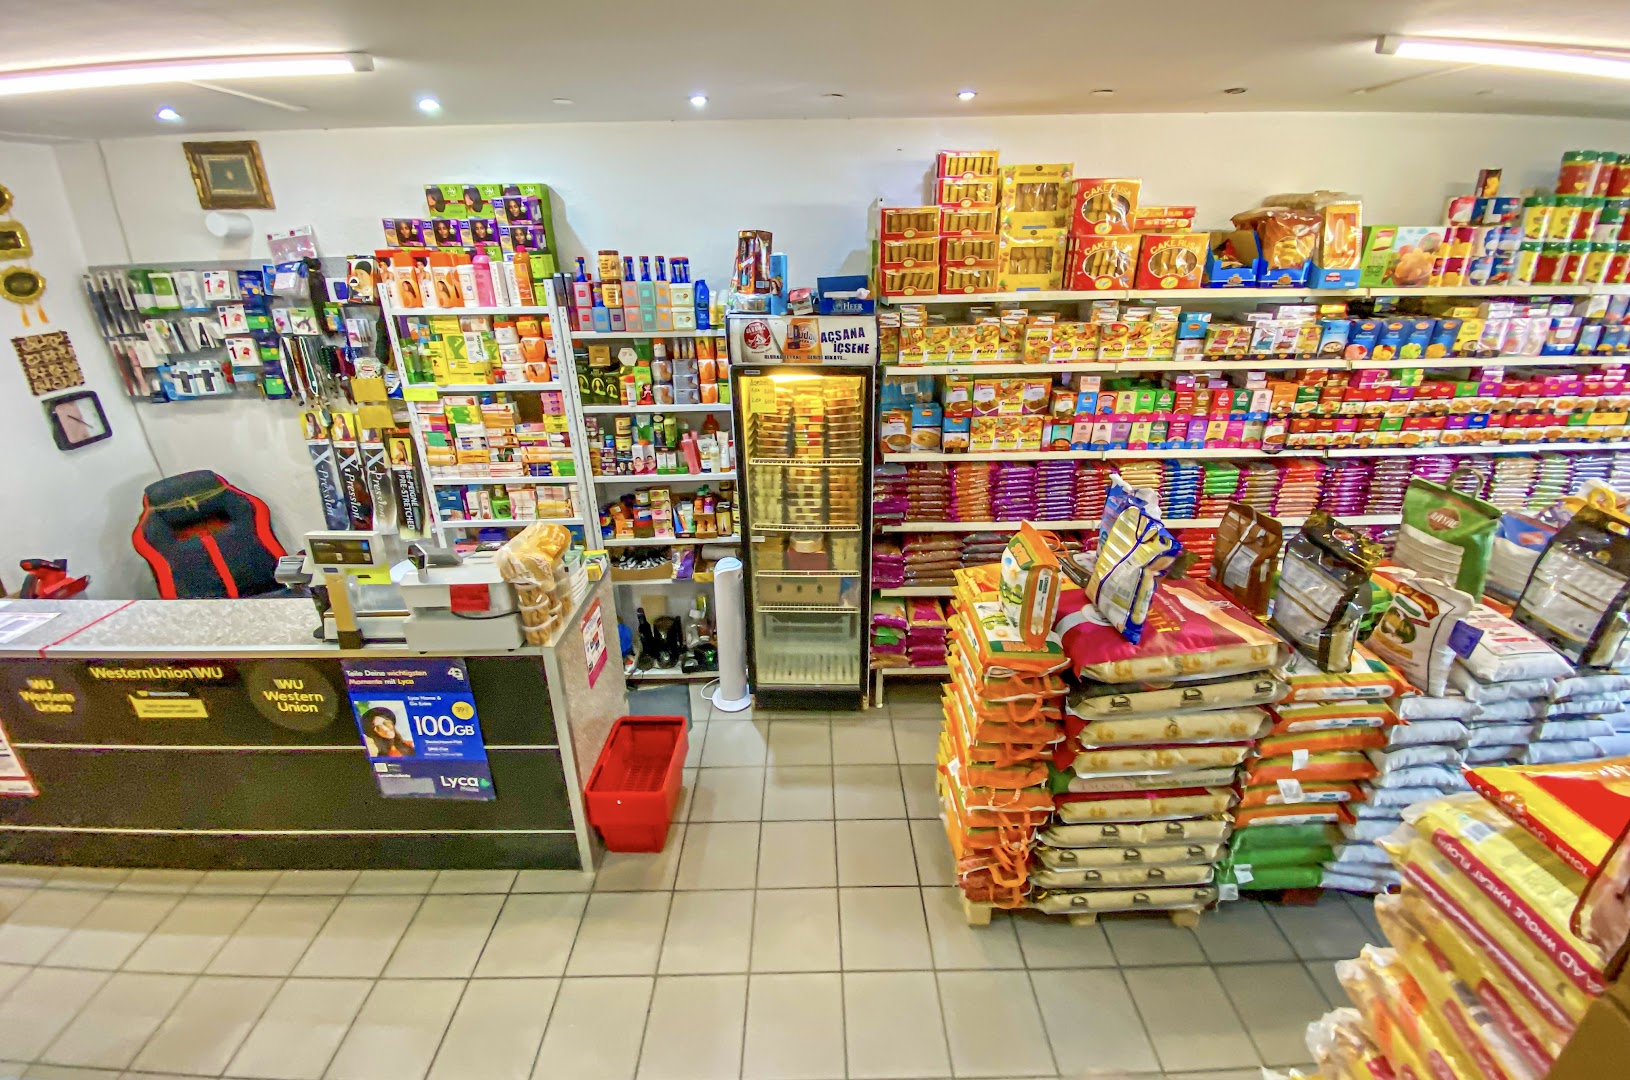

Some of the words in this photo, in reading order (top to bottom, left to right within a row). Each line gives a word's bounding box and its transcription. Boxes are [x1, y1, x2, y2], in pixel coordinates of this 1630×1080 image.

[1083, 184, 1109, 199] CAKE
[1084, 241, 1109, 256] CAKE
[1150, 240, 1176, 254] CAKE
[843, 302, 863, 310] HEER
[820, 327, 866, 344] AÇSANA
[398, 474, 415, 530] PRE-STRETCHED
[276, 680, 304, 690] WU
[263, 690, 324, 702] Western
[278, 702, 318, 712] Union
[440, 776, 480, 788] Lyca
[1474, 870, 1512, 910] WHEAT
[1515, 906, 1556, 952] WHOLE
